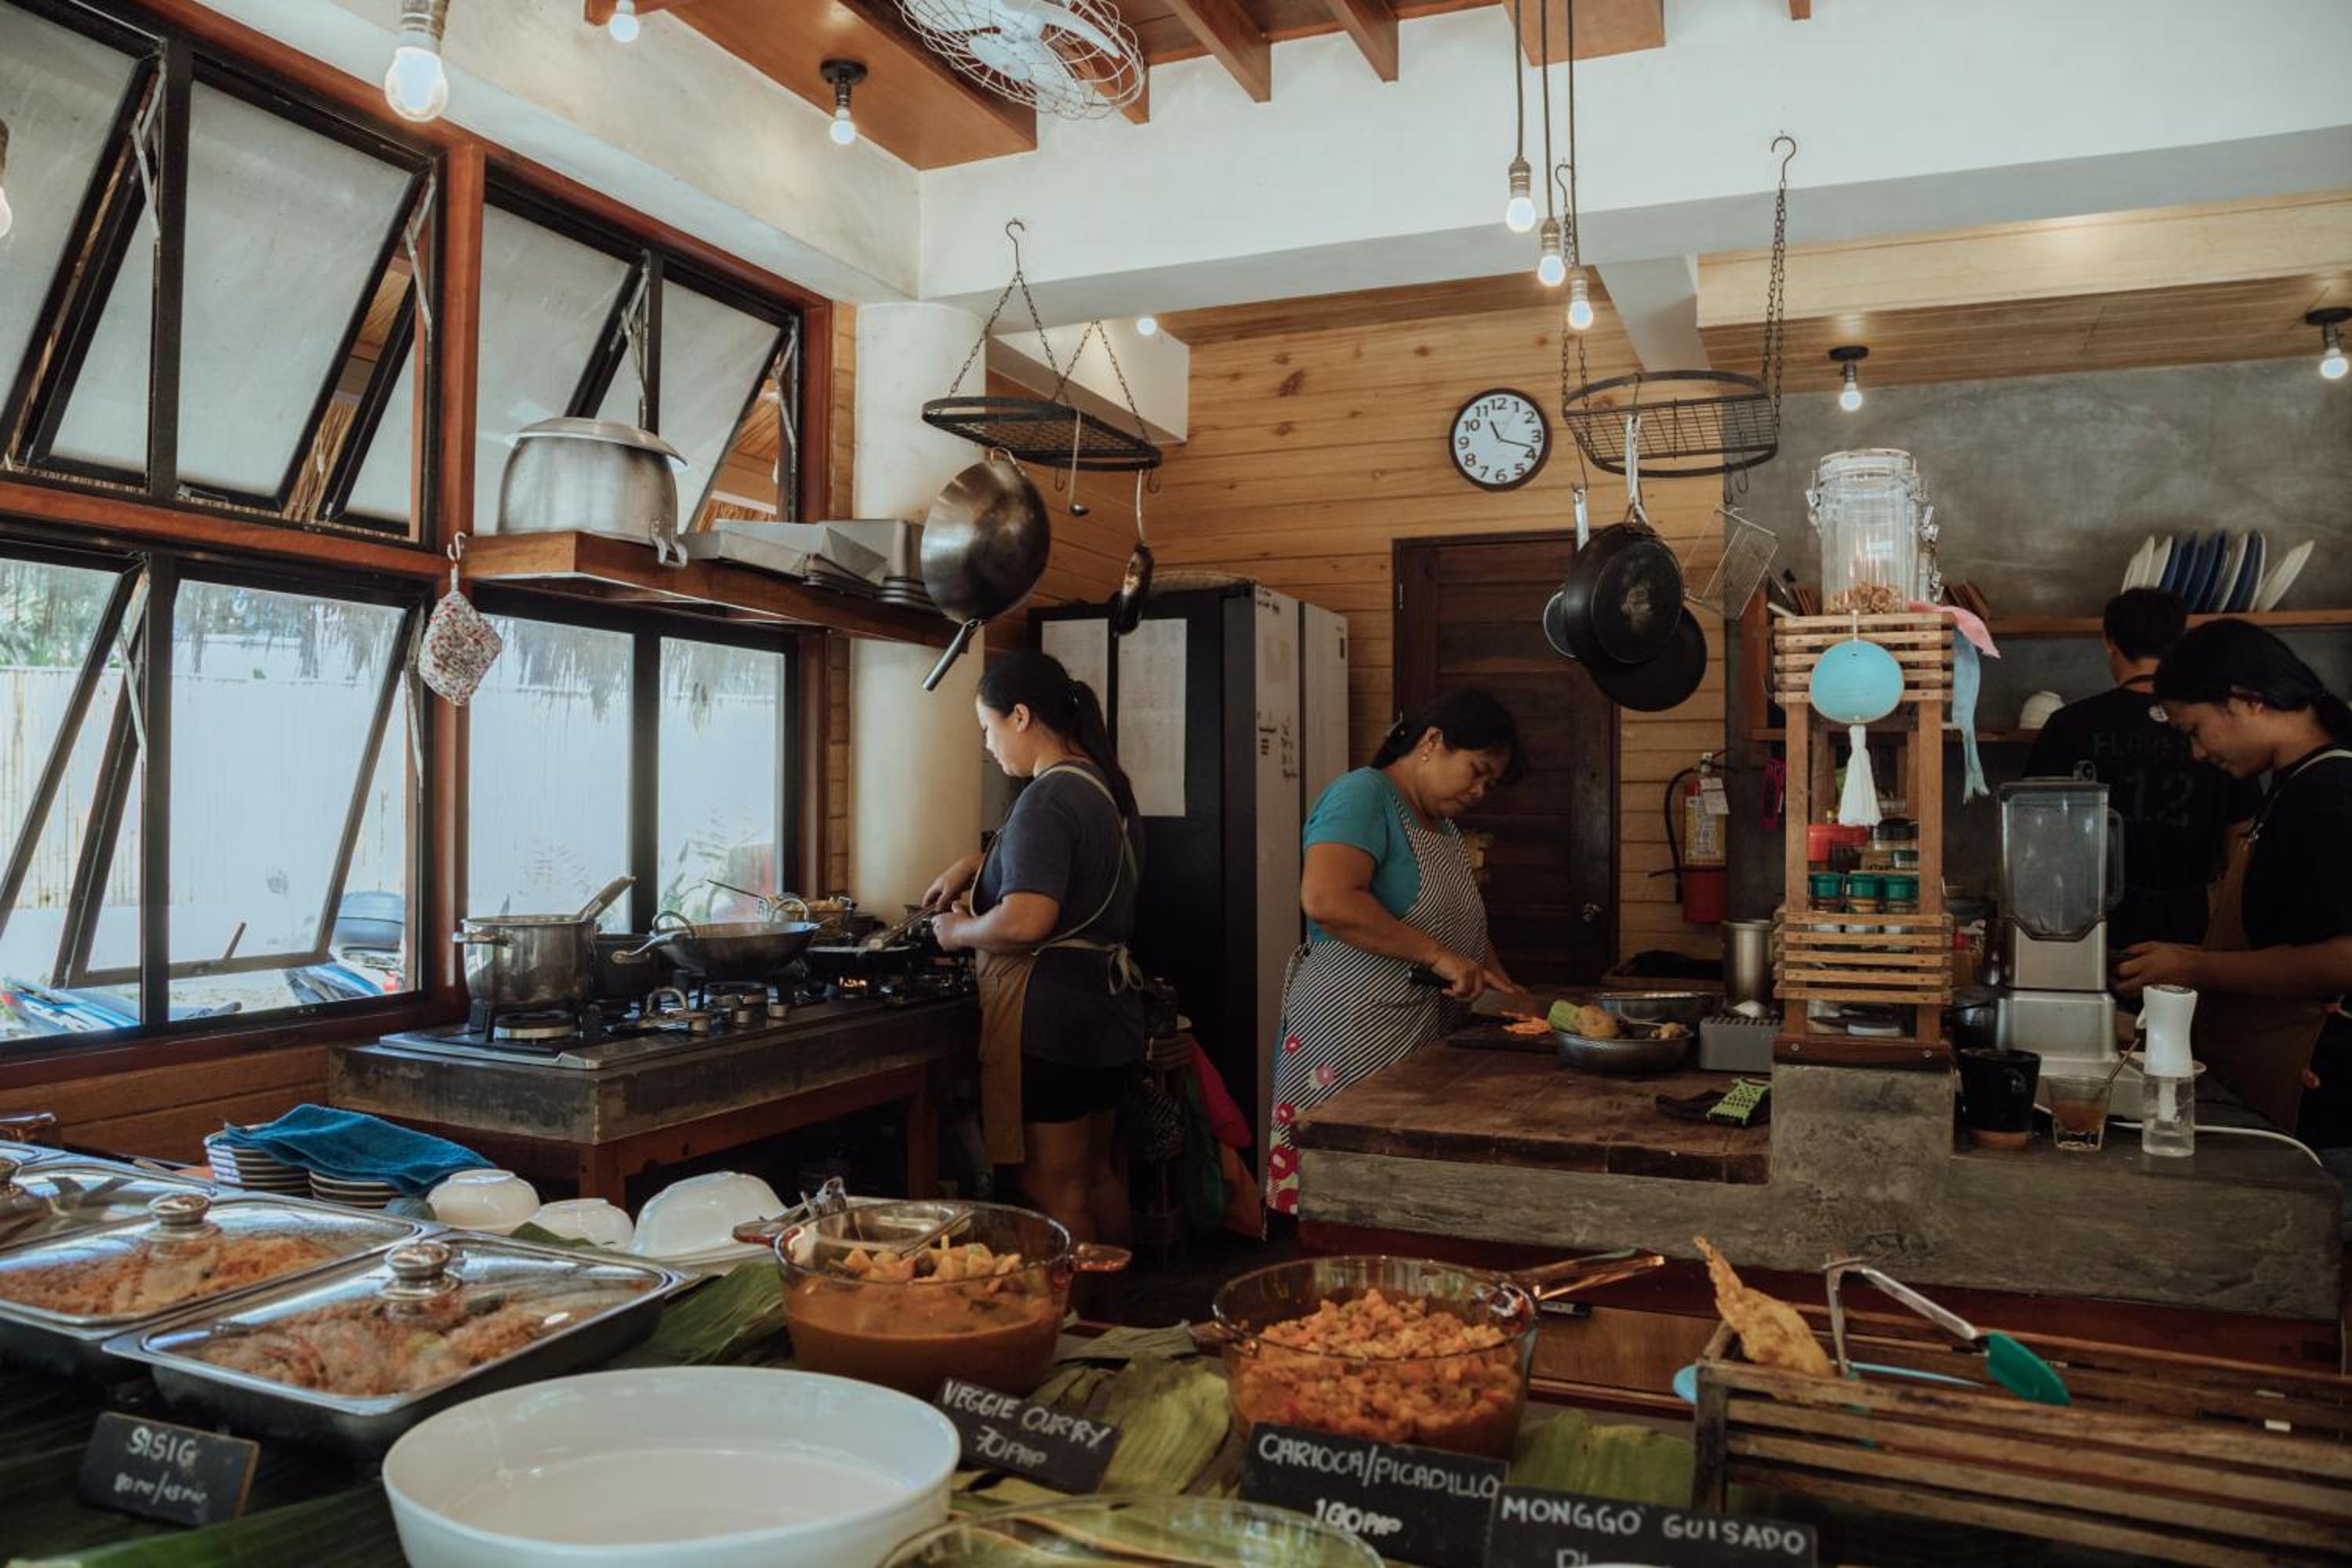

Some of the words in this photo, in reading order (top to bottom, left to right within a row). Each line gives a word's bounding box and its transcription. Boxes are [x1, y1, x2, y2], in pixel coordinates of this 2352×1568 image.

[1490, 397, 1507, 410] 12
[1475, 405, 1489, 417] 11
[1524, 411, 1535, 423] 2
[1464, 419, 1480, 432] 10
[1531, 430, 1541, 443] 3
[1458, 437, 1470, 450] 9
[1465, 453, 1476, 467] 8
[1524, 447, 1536, 461] 4
[1480, 466, 1489, 478] 7
[1495, 469, 1507, 481] 6
[1514, 463, 1525, 476] 5
[943, 1381, 1019, 1418] VEGGIE
[1022, 1407, 1111, 1449] CURRY
[126, 1425, 198, 1468] SISIG
[1258, 1434, 1498, 1498] CARIOCA/PICADILLO
[1501, 1497, 1642, 1534] MONGGO
[1663, 1515, 1804, 1555] GUISADO
